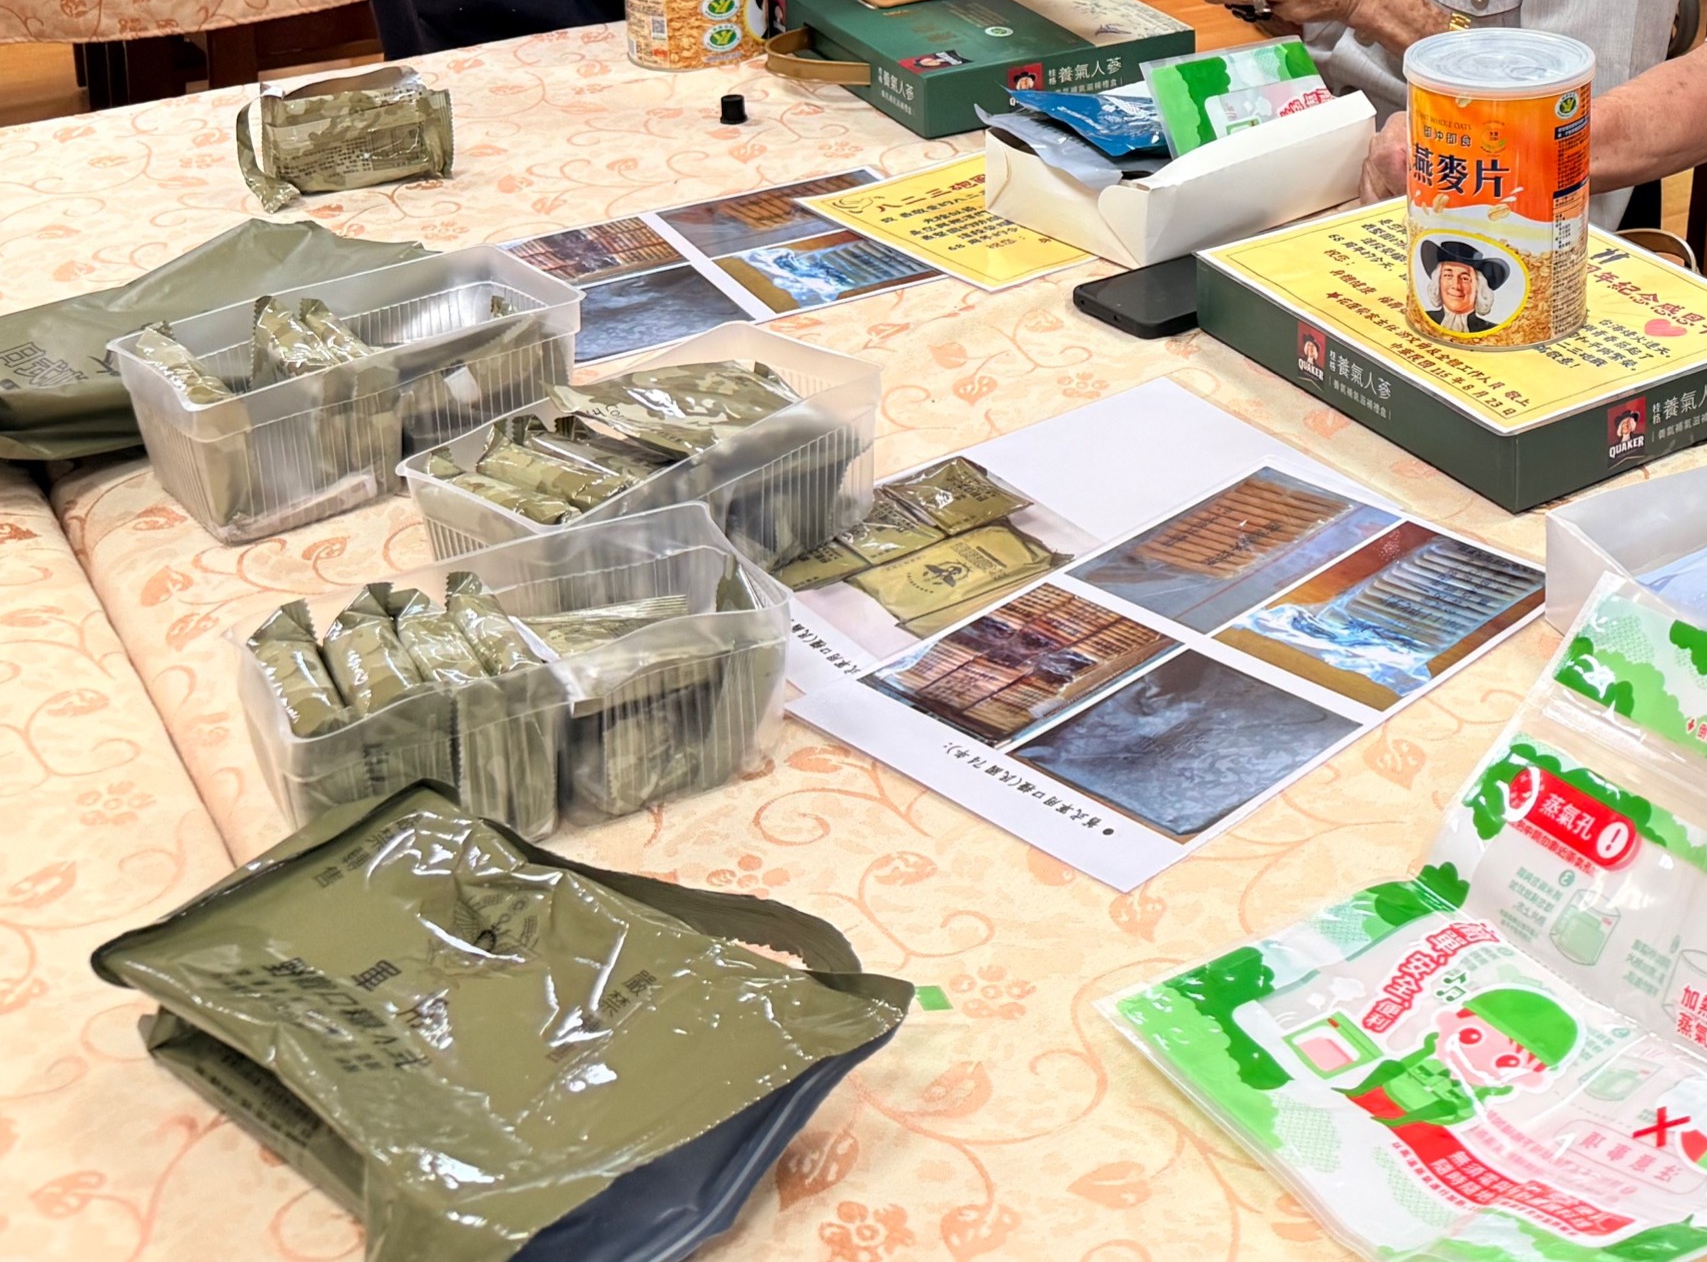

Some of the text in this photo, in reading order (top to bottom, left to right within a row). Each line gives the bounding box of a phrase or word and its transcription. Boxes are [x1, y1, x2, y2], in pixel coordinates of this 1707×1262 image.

[1057, 57, 1122, 84] 養氣人蔘
[1413, 142, 1510, 198] 燕麥片
[1298, 357, 1324, 382] QUAKER
[1337, 354, 1392, 401] 養氣人蔘
[1609, 435, 1645, 459] QUAKER
[1538, 793, 1599, 841] 蒸氣孔
